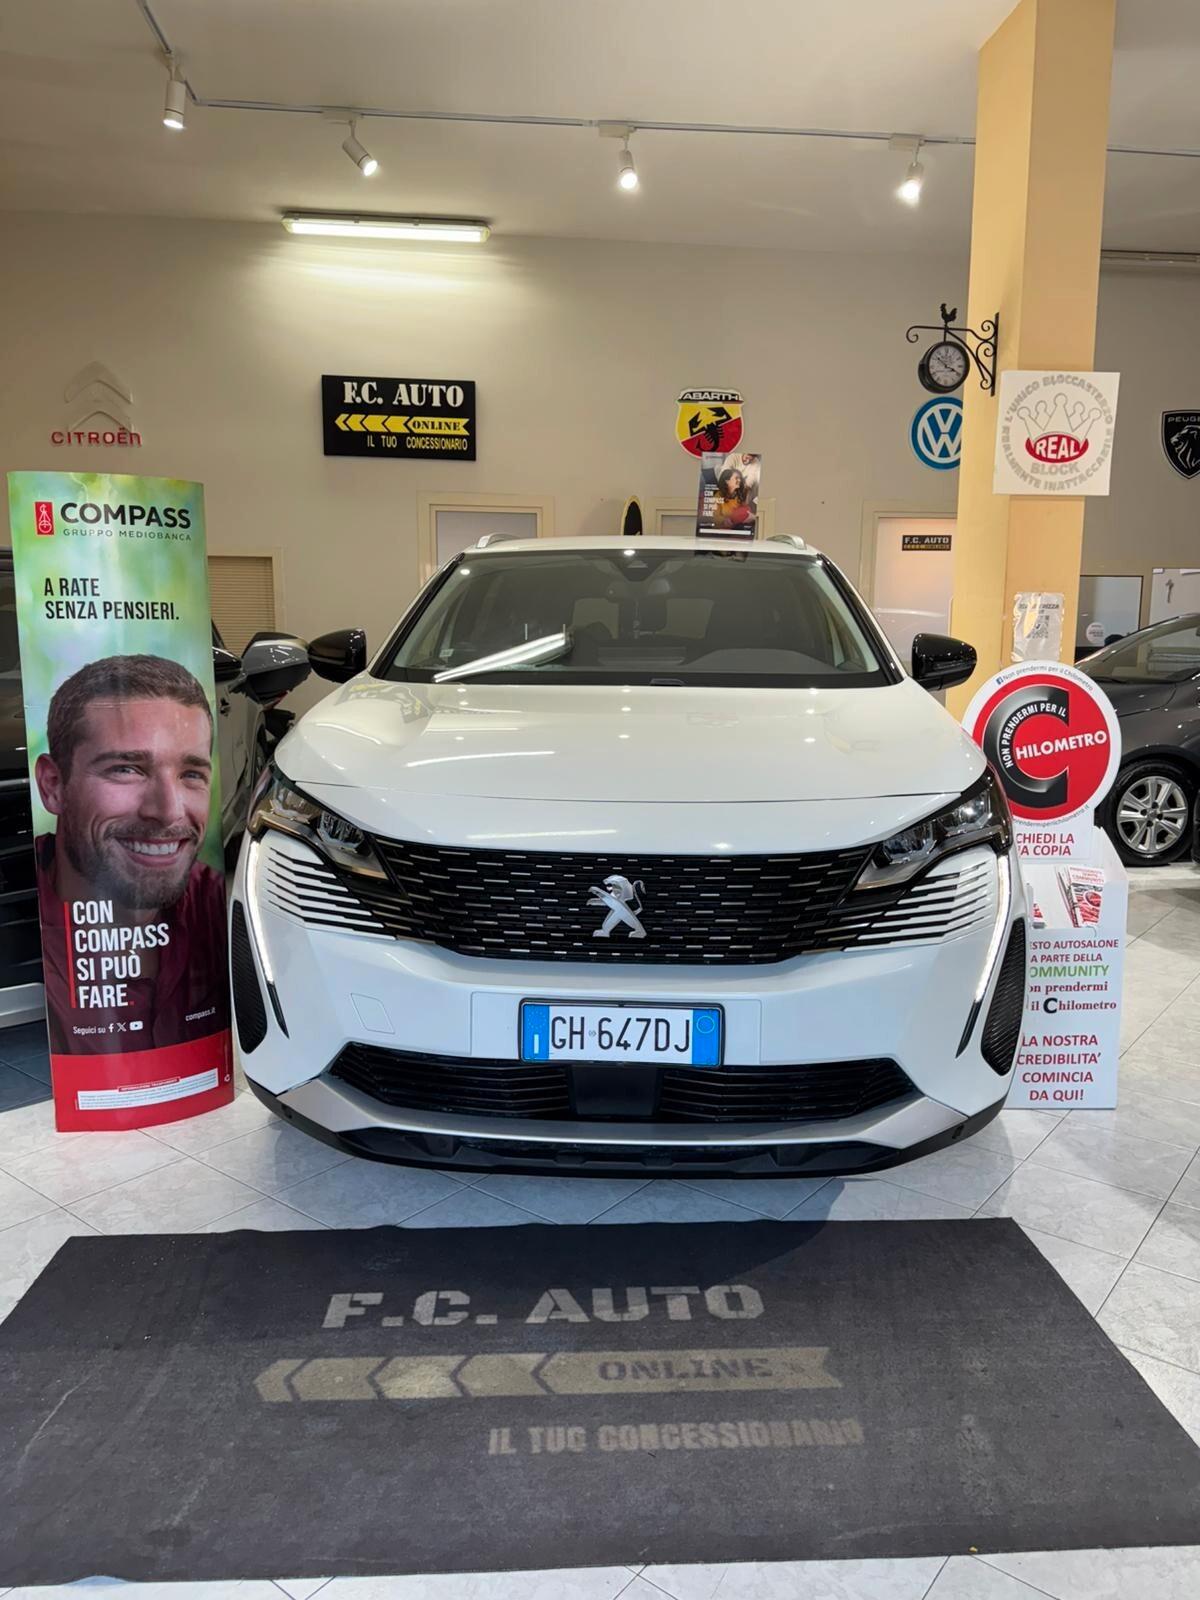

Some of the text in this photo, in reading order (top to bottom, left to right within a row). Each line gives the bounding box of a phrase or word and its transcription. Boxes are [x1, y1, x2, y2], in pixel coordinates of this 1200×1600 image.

[343, 382, 464, 408] F.C. AUTO
[683, 391, 739, 401] ABARTH
[412, 418, 461, 432] ONLINE
[367, 435, 468, 451] IL TUO CONCESSIONARIO
[1036, 436, 1080, 460] REAL
[1030, 461, 1080, 476] BLOCK
[61, 502, 191, 530] COMPASS
[63, 528, 192, 541] GRUPPO MEDIOBANCA
[44, 577, 100, 597] A RATE
[45, 601, 180, 620] SENZA PENSIERI.
[1002, 703, 1067, 769] NON PRENDERMI PER IL
[1060, 833, 1074, 844] LA
[1033, 845, 1072, 856] COPIA
[73, 899, 114, 924] CON
[74, 922, 170, 953] COMPASS
[1030, 939, 1119, 950] STO AUTOSALONE
[76, 949, 141, 981] SI PUÒ
[1041, 954, 1070, 963] PARTE
[1073, 953, 1103, 962] DELLA
[1030, 965, 1109, 978] OMMUNITY
[1045, 981, 1108, 995] prendermi
[1031, 997, 1117, 1014] il Chilometro
[72, 1025, 97, 1035] Seguici
[98, 1026, 106, 1034] su
[551, 1016, 585, 1050] GH
[598, 1017, 690, 1053] 647DJ
[1022, 1034, 1098, 1047] LA NOSTRA
[1022, 1071, 1094, 1083] COMINCIA
[1029, 1089, 1084, 1102] DA QUI!
[321, 1284, 765, 1329] F.C. AUTO
[598, 1357, 773, 1381] ONLINE
[488, 1426, 517, 1455] IL
